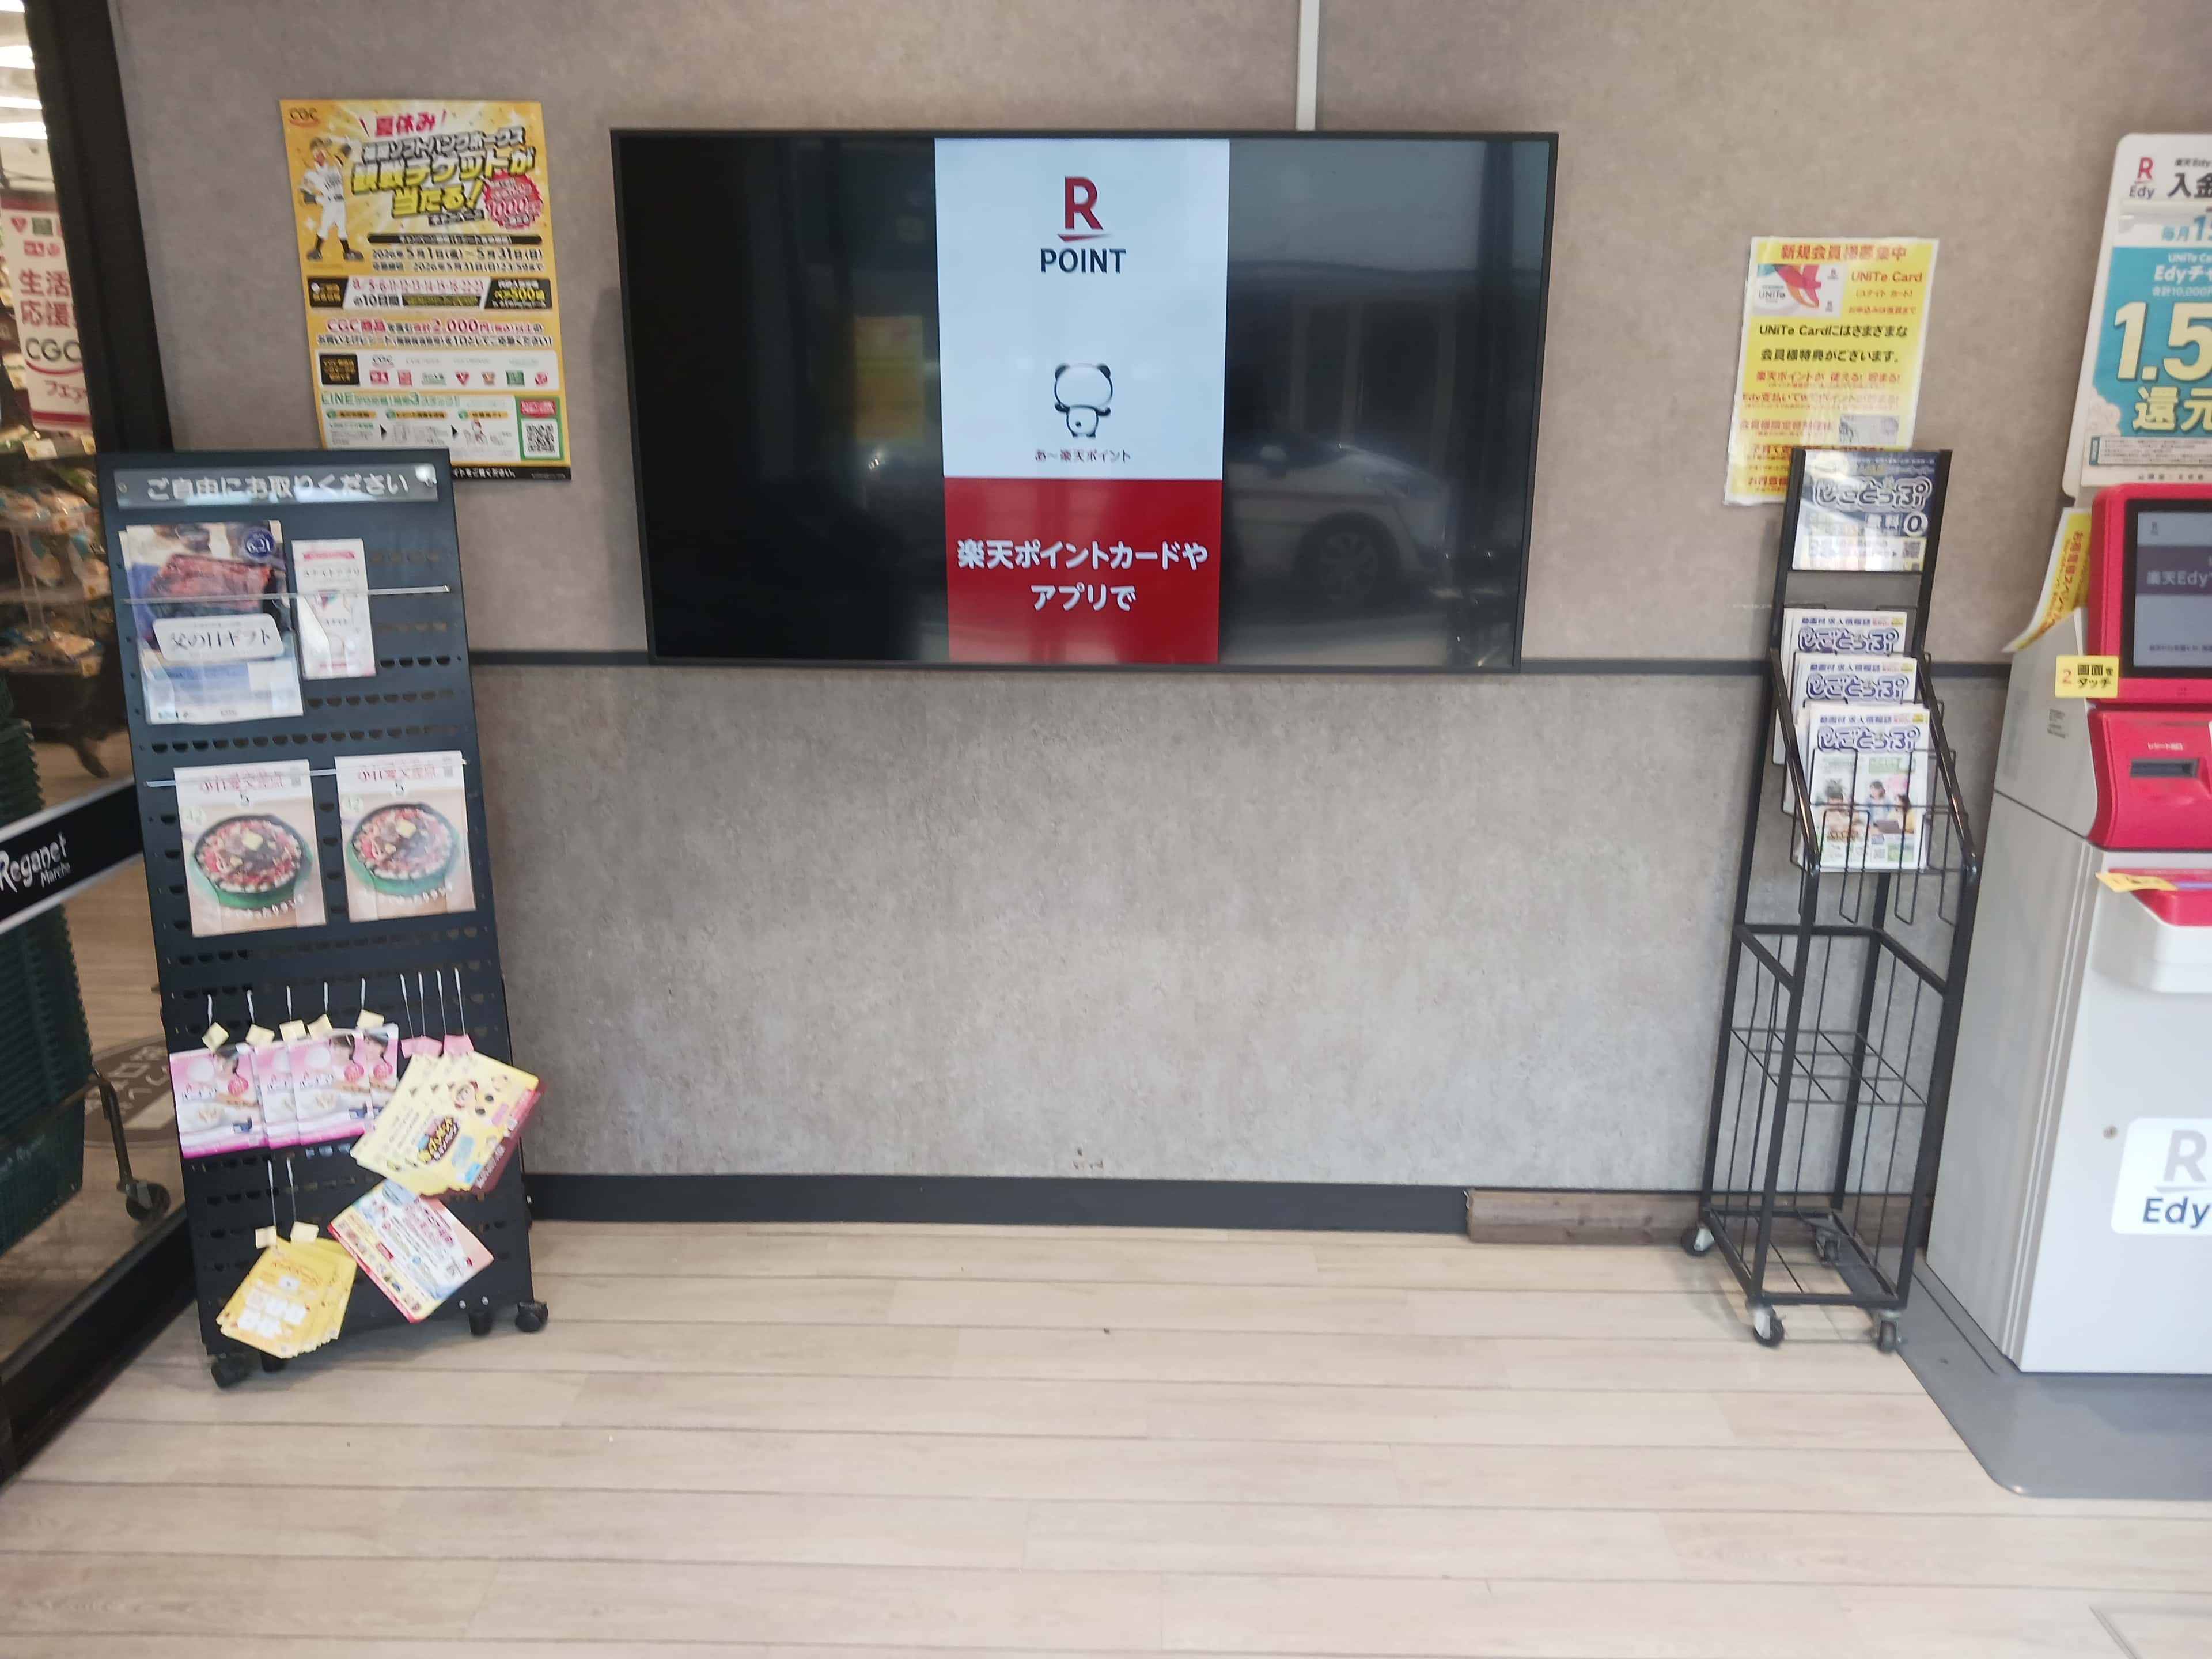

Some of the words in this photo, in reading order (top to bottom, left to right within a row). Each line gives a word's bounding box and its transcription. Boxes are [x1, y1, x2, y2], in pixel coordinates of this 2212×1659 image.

[2129, 185, 2155, 199] Edy
[2162, 215, 2212, 241] 毎月1
[1041, 248, 1127, 274] POINT
[18, 269, 71, 298] 生活
[1892, 271, 1923, 282] Card
[20, 300, 70, 328] 応援
[147, 473, 409, 502] ご自由にお取りください
[957, 538, 1208, 571] 楽天ポイントカードや
[2147, 570, 2212, 588] 楽天Edy
[1031, 582, 1137, 611] アプリで
[2062, 669, 2073, 684] 2
[2078, 678, 2111, 689] タッチ
[2142, 1196, 2211, 1230] Edy
